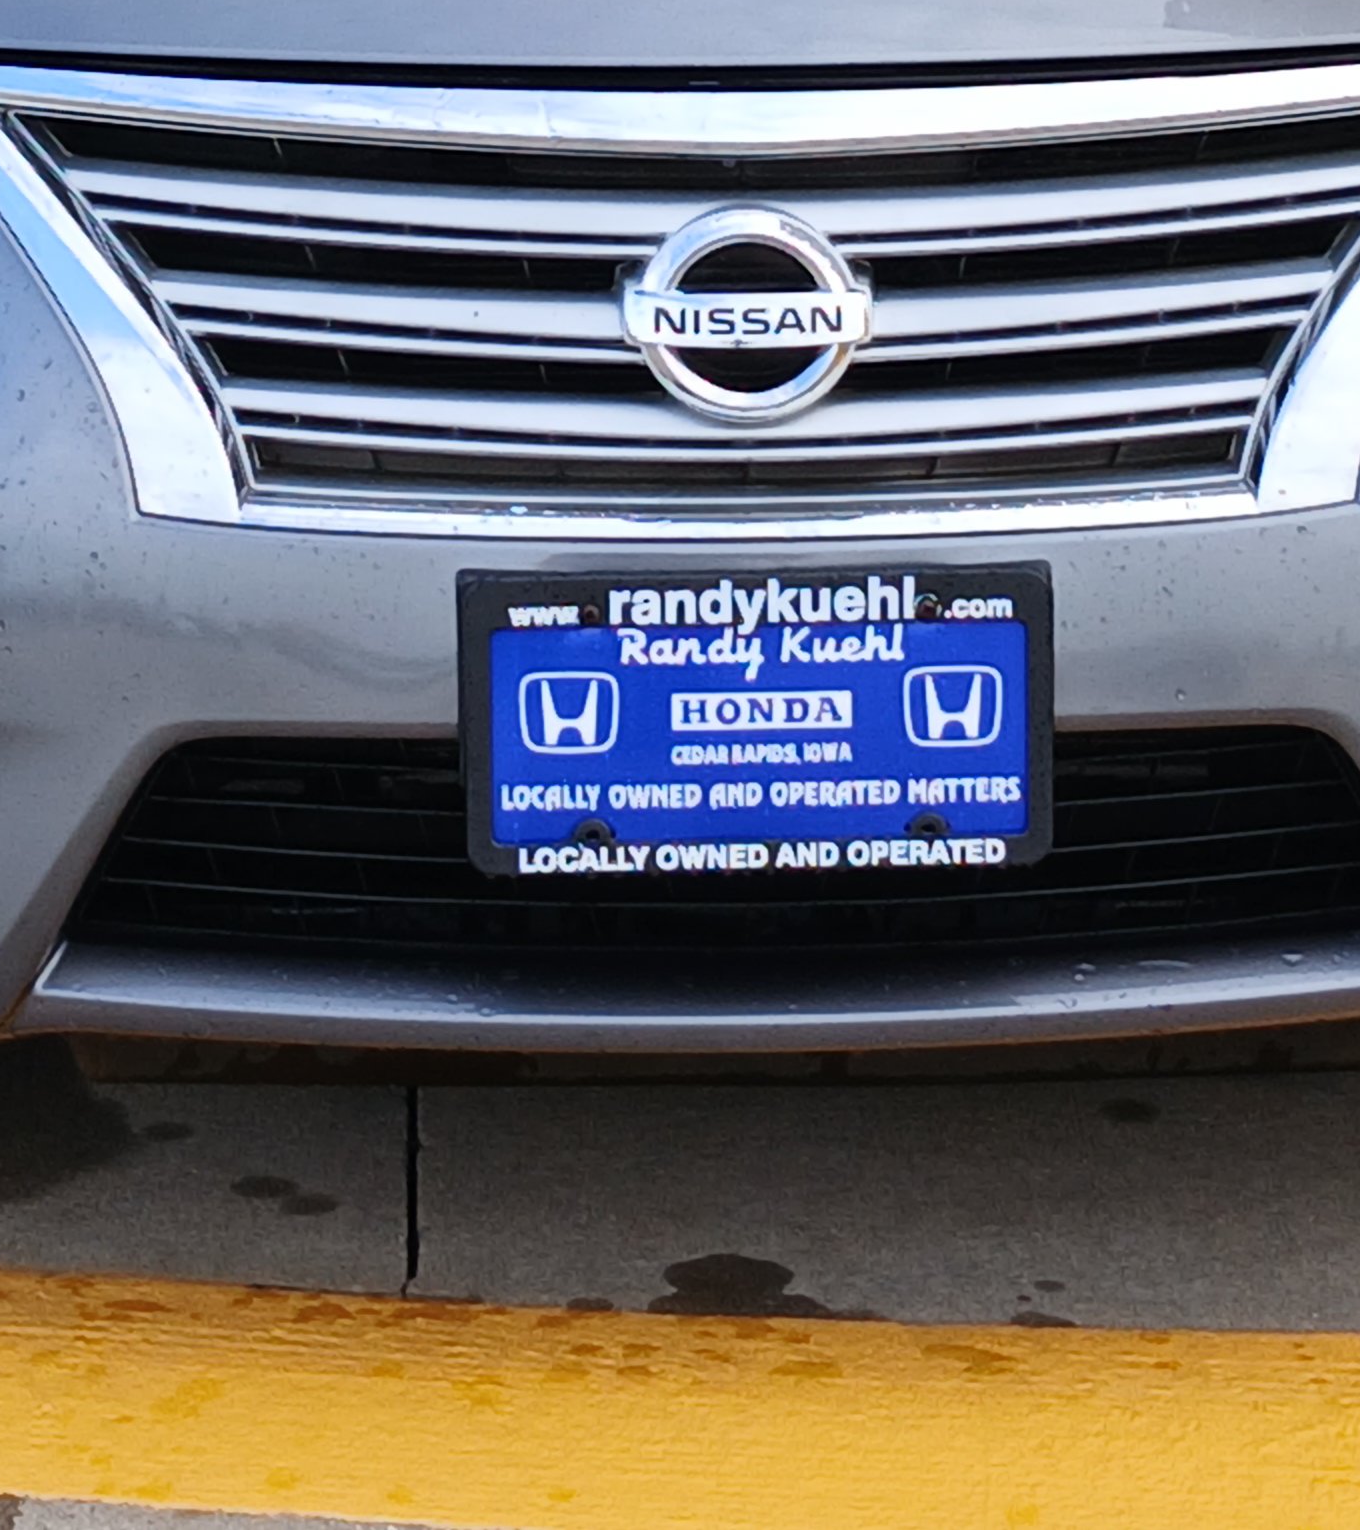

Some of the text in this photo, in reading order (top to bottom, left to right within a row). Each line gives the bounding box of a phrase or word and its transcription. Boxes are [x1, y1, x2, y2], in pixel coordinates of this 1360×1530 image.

[654, 306, 842, 335] NISSAN
[617, 623, 905, 681] Randy Kuehl
[680, 697, 842, 724] HONDA
[671, 745, 729, 765] CEDAR
[803, 741, 853, 762] IOWA
[501, 776, 1021, 811] LOCALLY OWNED AND OPERATED MATTERS
[519, 838, 1006, 873] LOCALLY OWNED AND OPERATED
